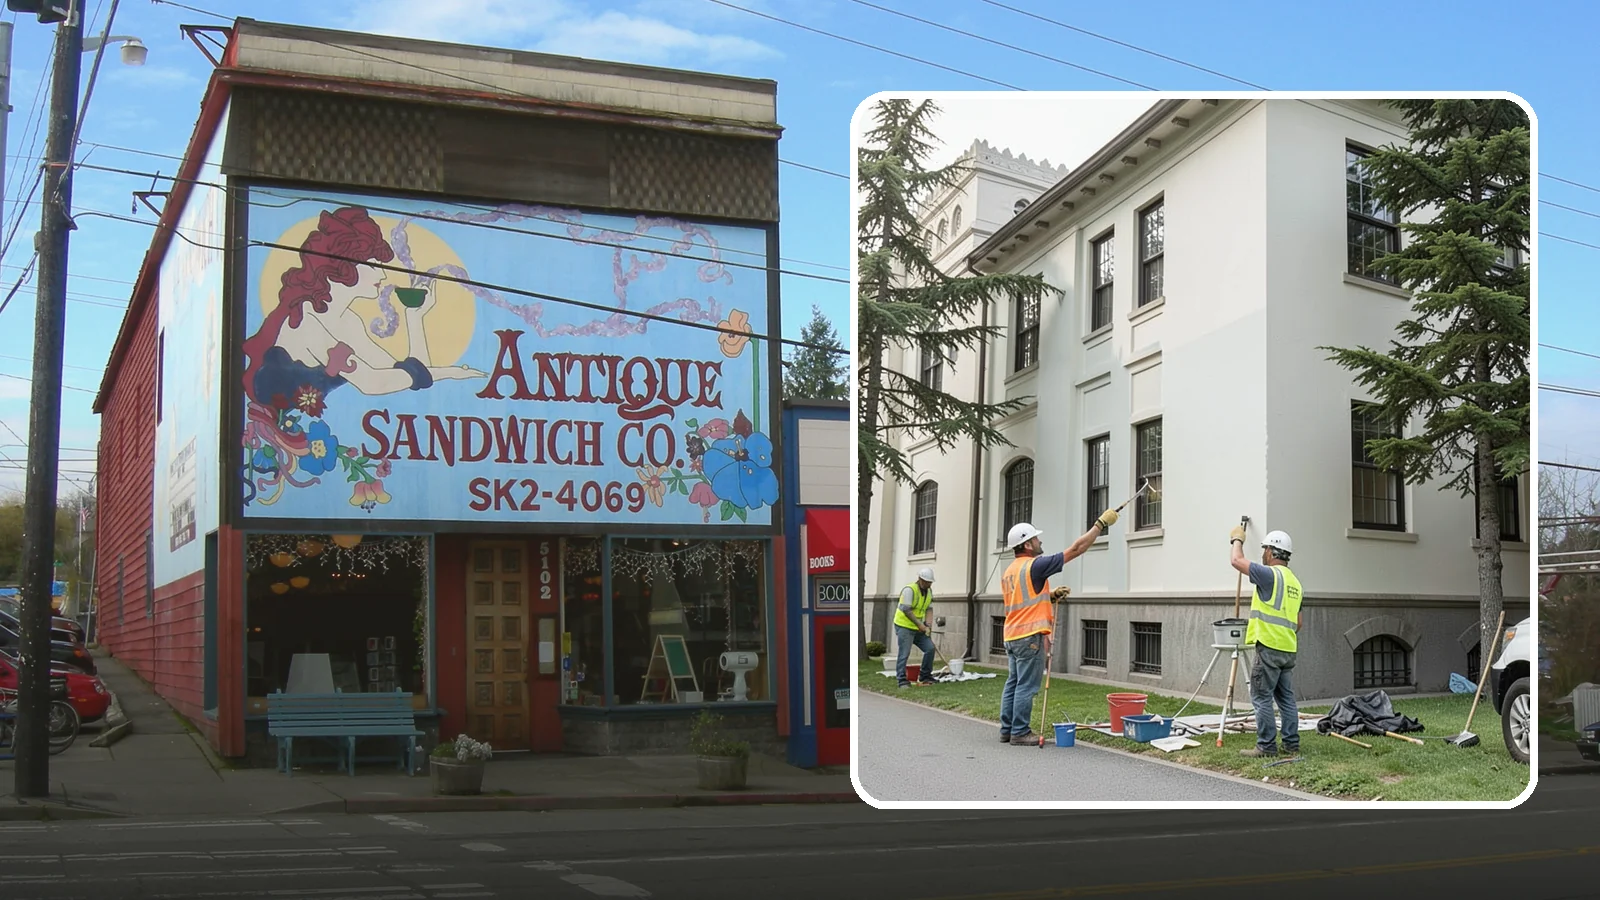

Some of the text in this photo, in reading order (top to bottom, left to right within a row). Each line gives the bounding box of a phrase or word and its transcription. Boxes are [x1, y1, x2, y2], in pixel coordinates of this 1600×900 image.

[476, 329, 723, 421] ANTIQUE
[361, 409, 685, 468] SANDWICH CO.
[468, 476, 646, 513] SK2-4069
[540, 541, 551, 600] 5102
[809, 555, 835, 569] BOOKS
